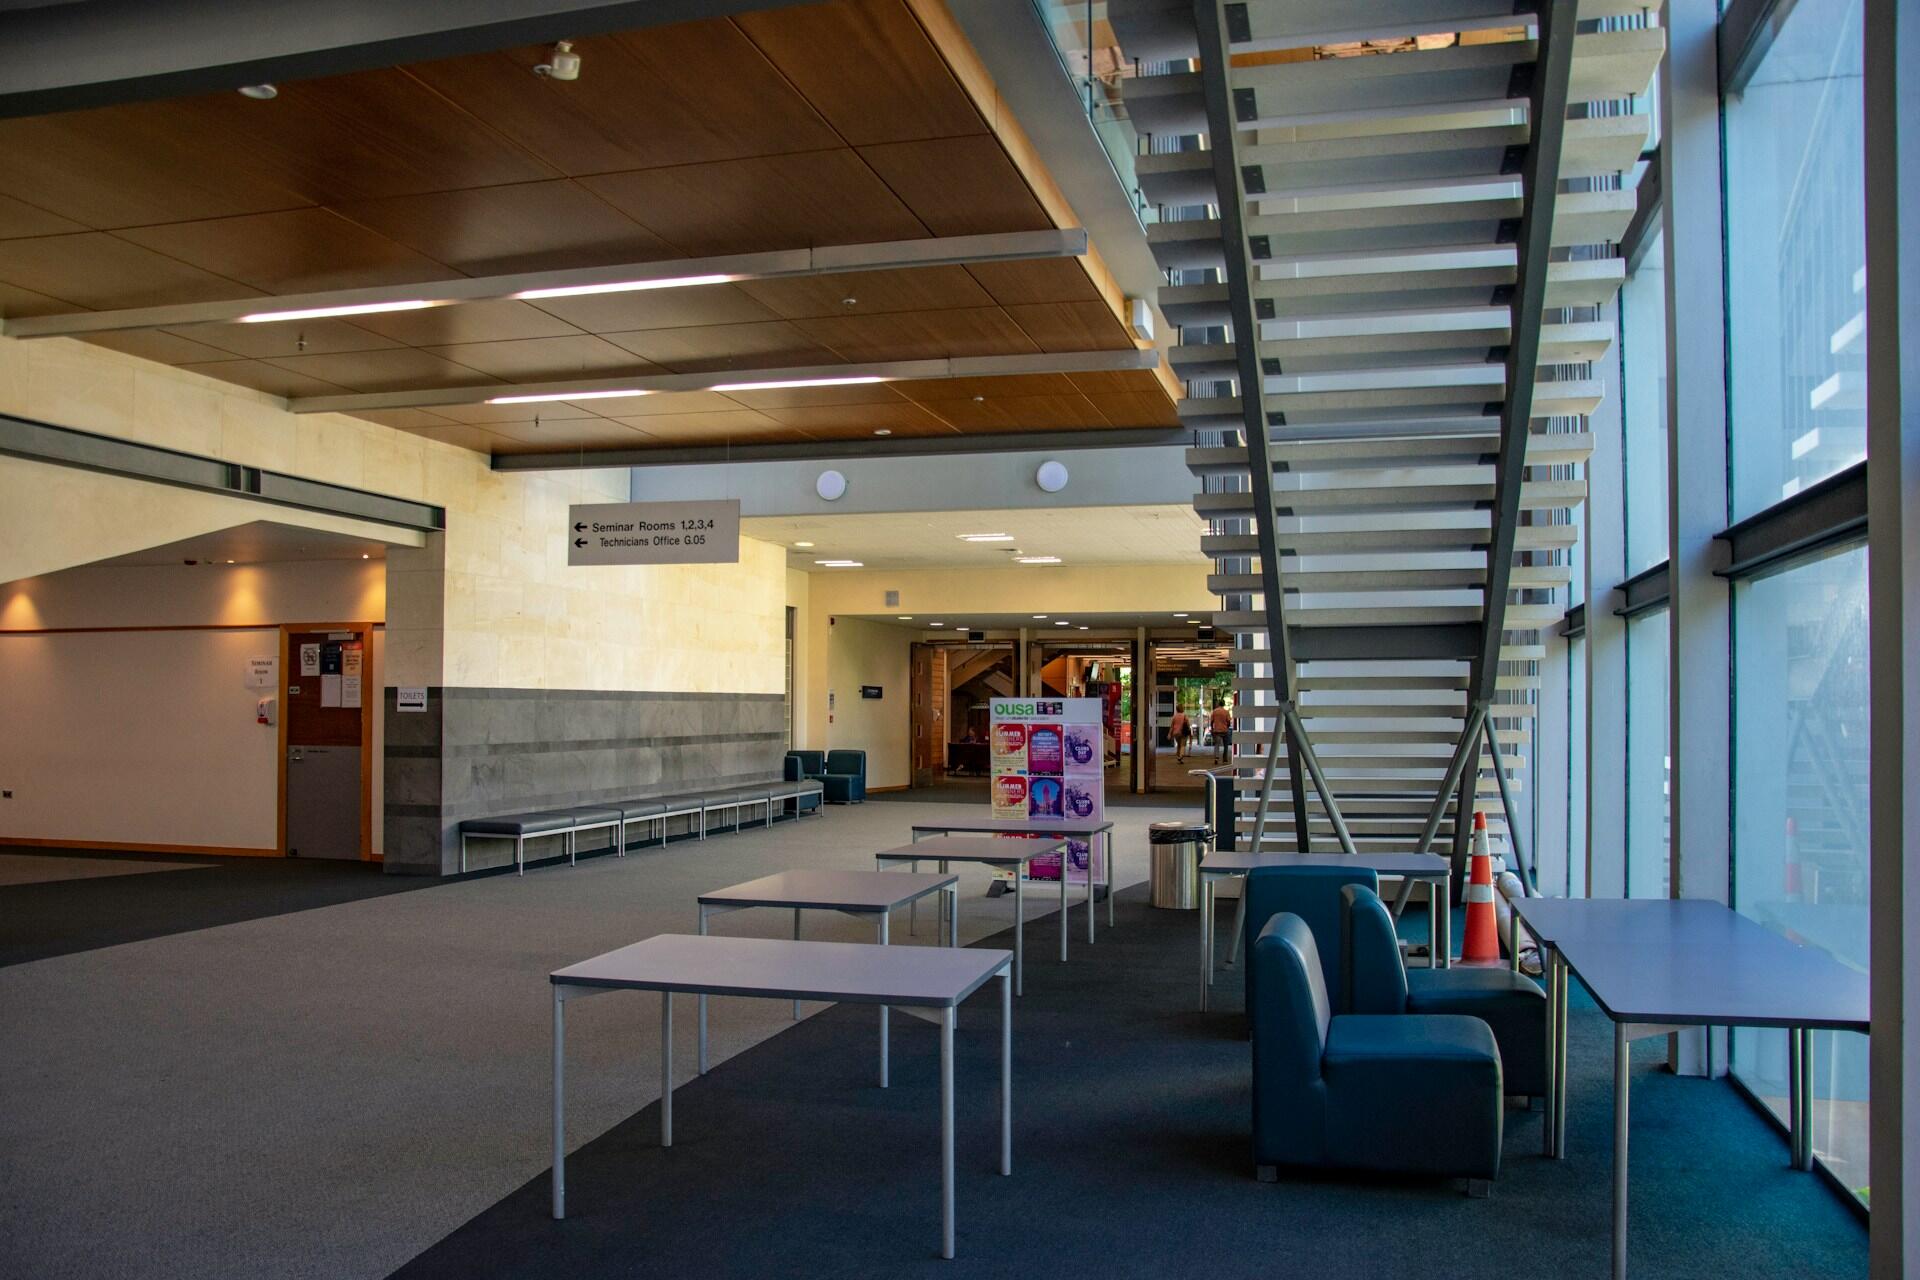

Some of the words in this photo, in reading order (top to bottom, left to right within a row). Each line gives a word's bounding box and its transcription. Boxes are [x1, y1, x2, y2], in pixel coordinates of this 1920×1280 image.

[592, 522, 634, 533] Seminar
[639, 520, 676, 531] Rooms
[681, 519, 714, 531] 1,2,3,4
[600, 536, 649, 547] Technicians
[653, 535, 680, 546] Office
[684, 534, 706, 545] G.05
[994, 703, 1034, 716] ousa
